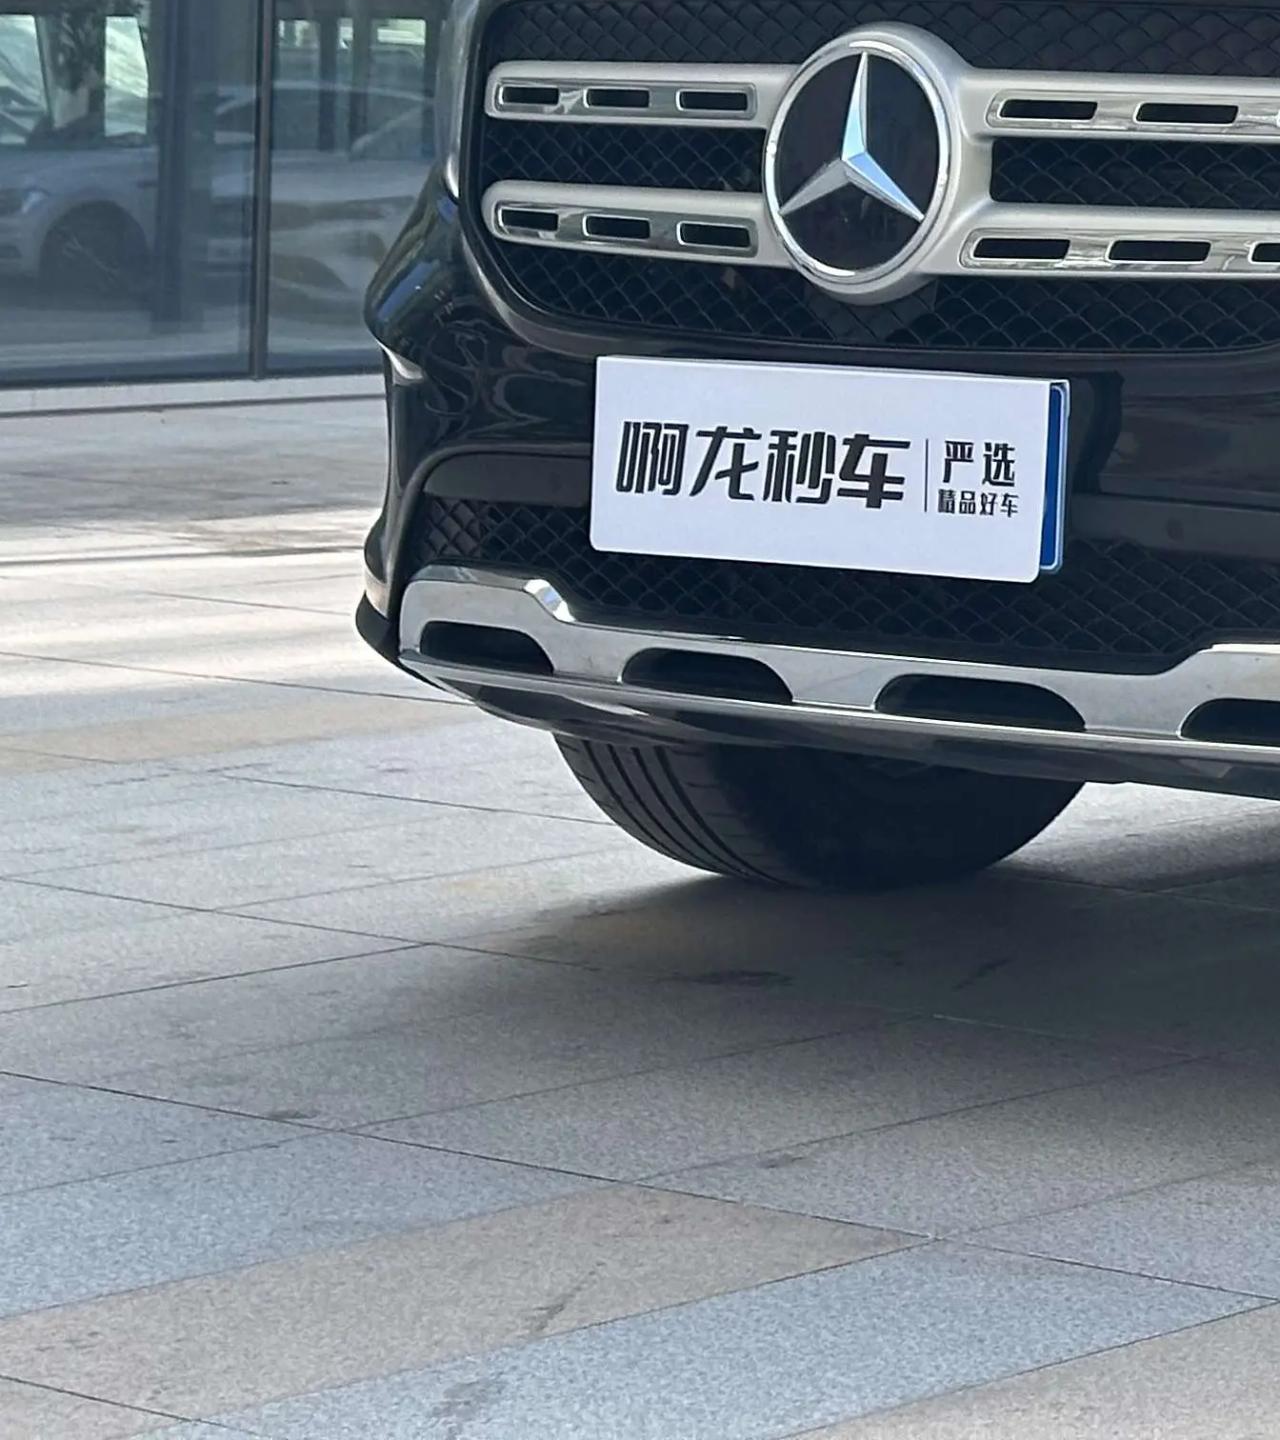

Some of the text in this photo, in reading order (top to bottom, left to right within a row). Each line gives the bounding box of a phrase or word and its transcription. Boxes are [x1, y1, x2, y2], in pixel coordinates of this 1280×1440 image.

[615, 421, 911, 510] 啊龙秒车
[942, 440, 1016, 488] 严选
[937, 488, 1019, 518] 精品好车
